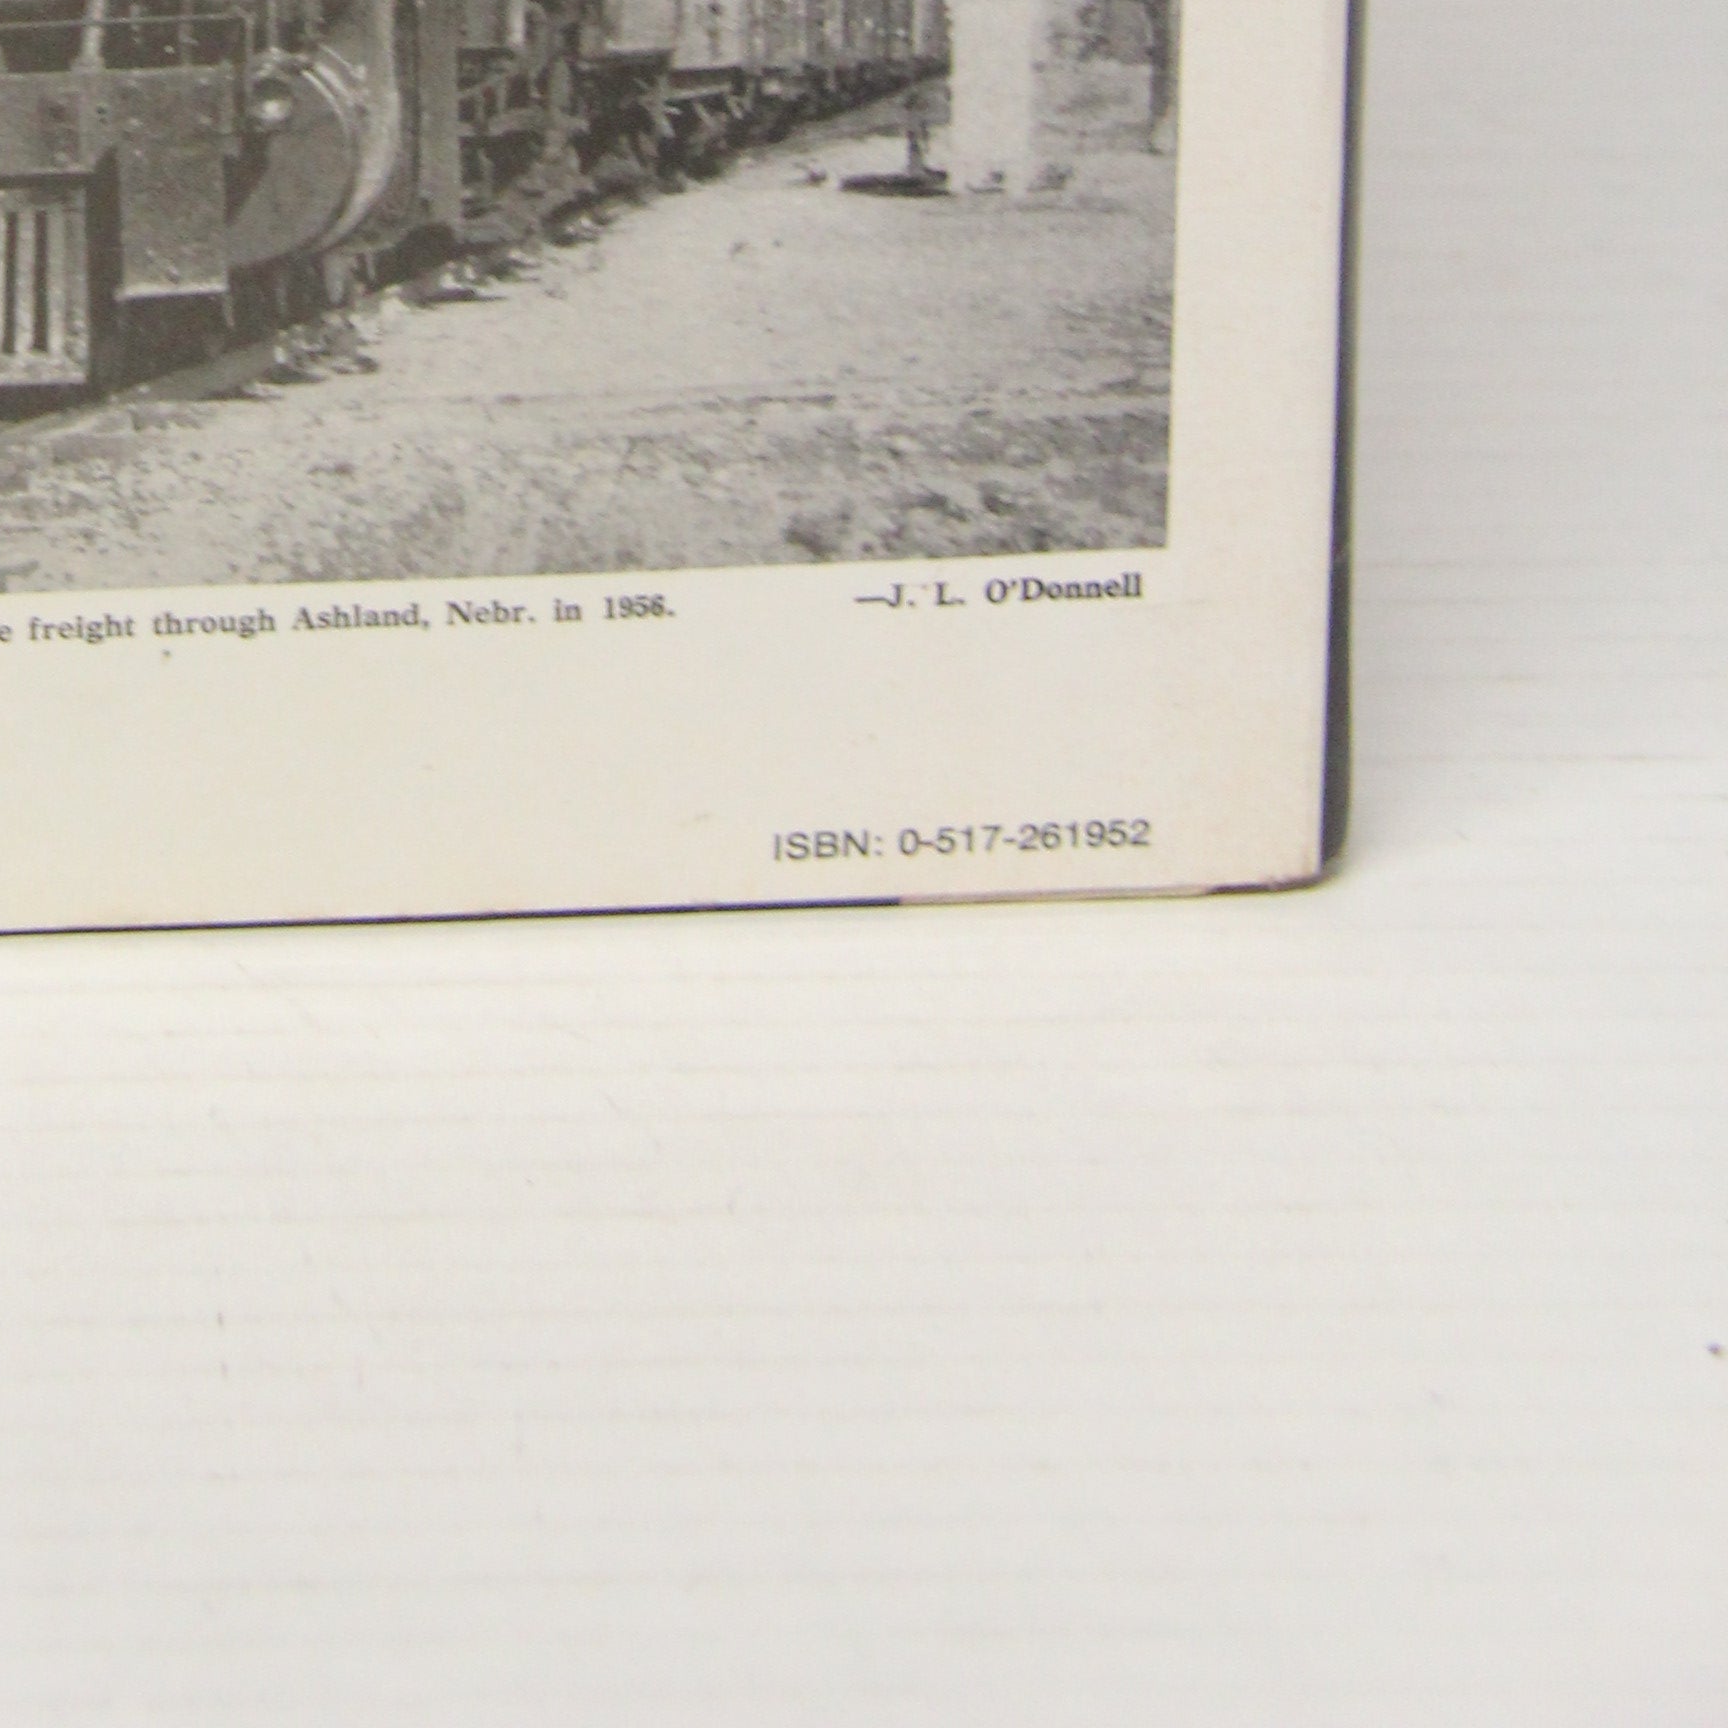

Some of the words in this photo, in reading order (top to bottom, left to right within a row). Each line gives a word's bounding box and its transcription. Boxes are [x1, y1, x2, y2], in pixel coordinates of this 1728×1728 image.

[935, 581, 966, 608] L.
[28, 613, 135, 645] freight
[152, 608, 276, 640] through
[292, 602, 430, 631] Ashland,
[446, 599, 536, 626] Nebr.
[554, 598, 582, 623] in
[774, 830, 882, 861] ISBN:
[898, 818, 1151, 857] 0-517-261952
